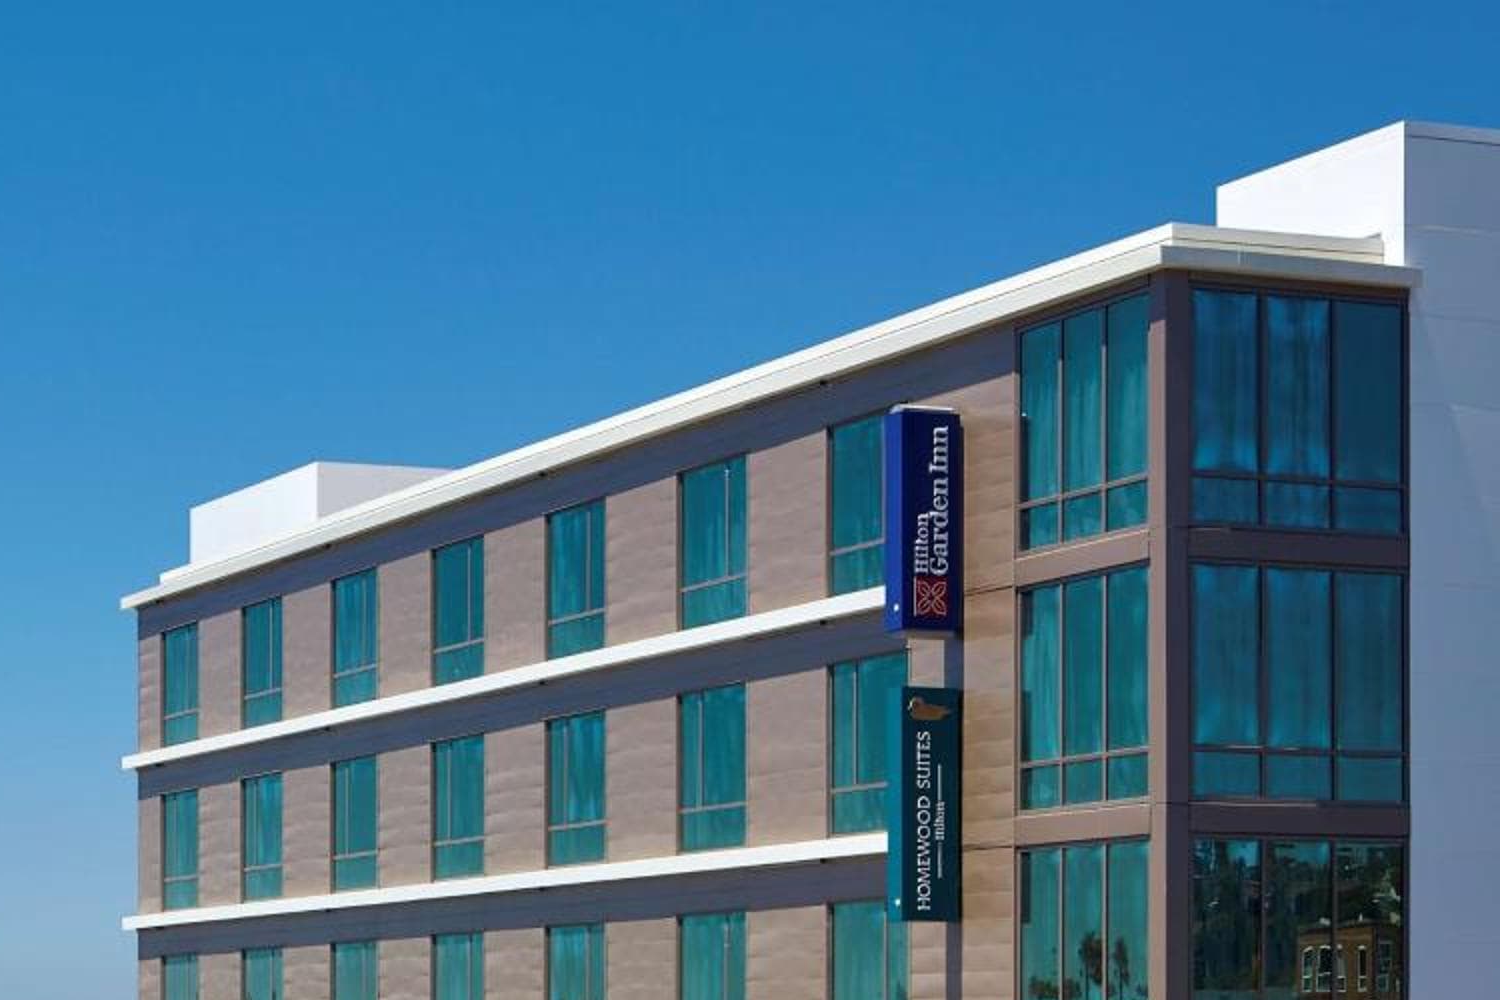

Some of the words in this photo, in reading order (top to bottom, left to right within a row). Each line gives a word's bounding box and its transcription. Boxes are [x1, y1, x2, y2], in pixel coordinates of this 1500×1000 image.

[929, 425, 950, 473] Inn
[914, 512, 930, 575] Hilton
[929, 478, 950, 575] Garden
[917, 730, 931, 789] SUITES
[917, 795, 931, 911] HOMEWOOD
